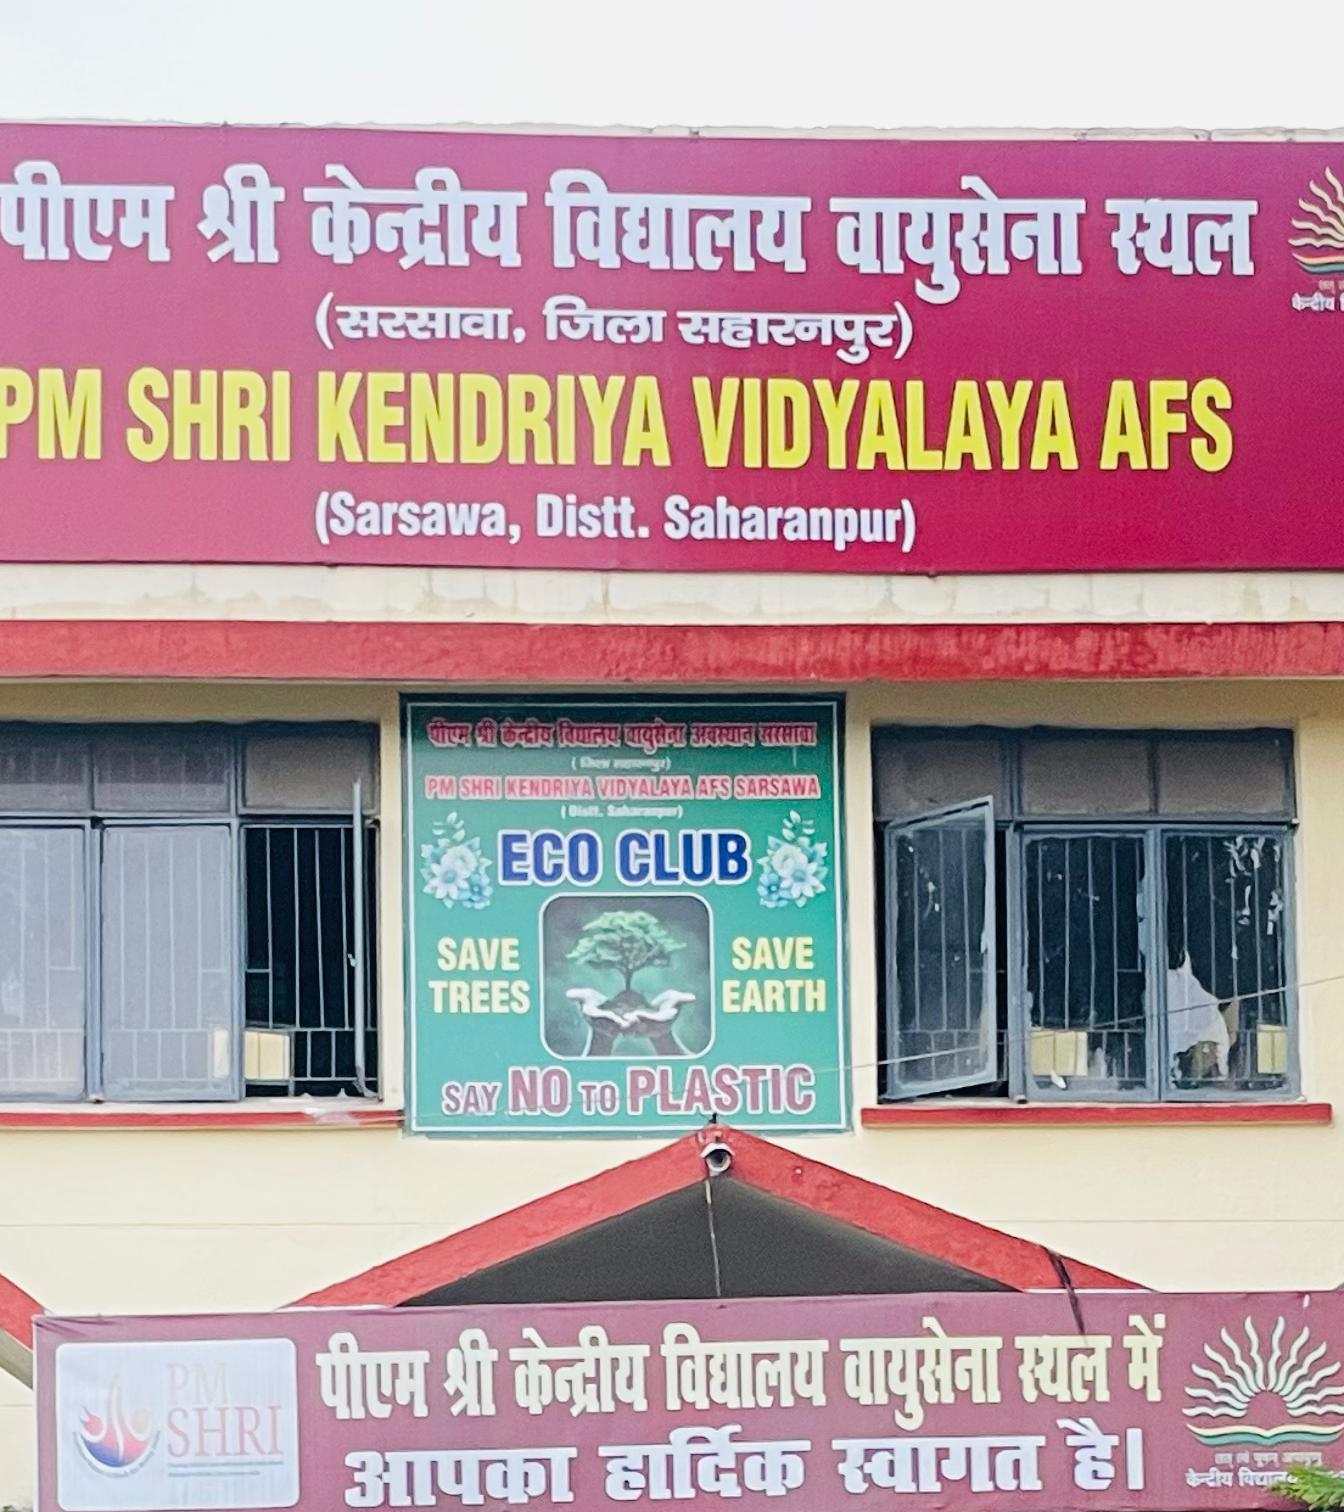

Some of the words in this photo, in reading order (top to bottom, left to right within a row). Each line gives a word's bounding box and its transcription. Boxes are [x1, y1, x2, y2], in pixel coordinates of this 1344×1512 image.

[197, 163, 286, 264] श्री
[303, 163, 528, 271] केन्द्रीय
[544, 168, 812, 274] विद्यालय
[829, 175, 1086, 305] वायुसेना
[315, 291, 527, 350] (सरसावा,
[542, 295, 667, 342] जिला
[677, 301, 914, 365] सहारनपुर)
[125, 366, 292, 463] SHRI
[317, 370, 671, 468] KENDRIYA
[692, 375, 1079, 472] VIDYALAYA
[1100, 378, 1234, 473] AFS
[315, 490, 522, 545] (Sarsawa,
[536, 493, 651, 539] Distt.
[664, 494, 916, 553] Saharanpur)
[425, 775, 456, 798] PM
[460, 775, 501, 798] SHRI
[505, 775, 594, 799] KENDRIYA
[596, 775, 694, 799] VIDYALAYA
[695, 775, 730, 799] AFS
[734, 775, 822, 799] SARSAWA
[498, 829, 602, 886] ECO
[616, 829, 752, 886] CLUB
[437, 938, 520, 971] SAVE
[731, 937, 814, 970] SAVE
[428, 980, 531, 1014] TREES
[722, 979, 826, 1013] EARTH
[442, 1081, 501, 1115] SAY
[508, 1065, 570, 1115] NO
[578, 1084, 618, 1114] TO
[627, 1064, 816, 1115] PLASTIC
[168, 1362, 229, 1401] PM
[315, 1332, 431, 1420] पीएम
[444, 1328, 499, 1417] श्री
[508, 1325, 651, 1417] केन्द्रीय
[659, 1322, 829, 1411] विद्यालय
[838, 1316, 1003, 1432] वायुसेना
[1122, 1313, 1167, 1403] में
[167, 1406, 283, 1457] SHRI
[344, 1446, 578, 1508] आपका
[597, 1423, 812, 1502] हार्दिक
[831, 1435, 1046, 1495] स्वागत
